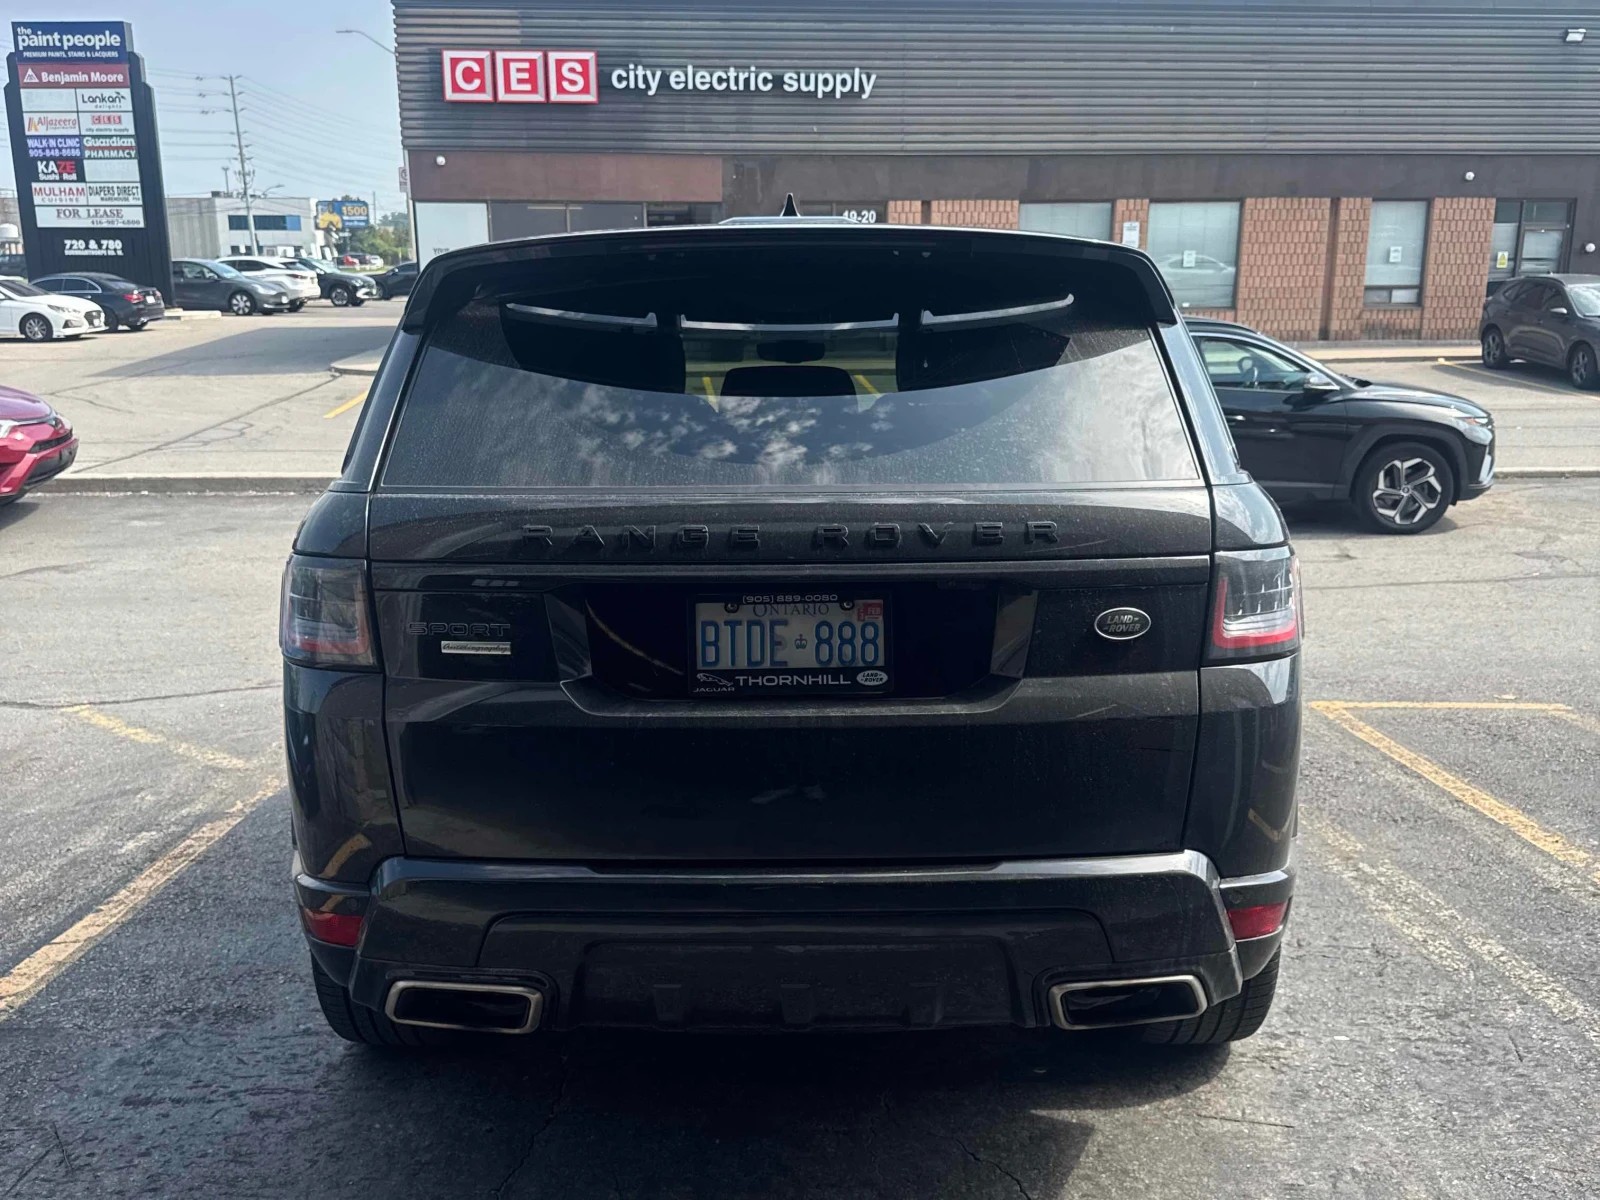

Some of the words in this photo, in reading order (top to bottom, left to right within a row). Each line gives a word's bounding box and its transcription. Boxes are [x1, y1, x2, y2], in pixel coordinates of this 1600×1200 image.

[17, 26, 32, 34] the
[18, 30, 61, 50] paint
[62, 30, 121, 50] people
[41, 71, 88, 85] Benjamin
[91, 72, 124, 82] Moore
[454, 59, 587, 94] CES
[610, 63, 662, 97] city
[668, 64, 773, 93] electric
[782, 67, 877, 100] supply
[82, 92, 121, 103] Lankan
[37, 116, 77, 131] Aljazeera
[27, 138, 56, 148] WALK-IN
[57, 138, 80, 148] CLINIC
[83, 136, 136, 146] Guardian
[84, 149, 136, 158] PHARMACY
[37, 160, 76, 173] KAZE
[34, 187, 86, 196] MULHAM
[88, 186, 115, 196] DIAPERS
[117, 186, 139, 196] DIRECT
[56, 208, 81, 218] FOR
[86, 208, 124, 218] LEASE
[342, 206, 367, 216] 1500
[842, 210, 876, 223] 19-20
[64, 239, 86, 250] 720
[88, 239, 98, 250] &
[101, 239, 122, 250] 780
[522, 523, 761, 550] RANGE
[817, 521, 1059, 548] ROVER
[752, 602, 830, 617] ONTARIO
[408, 622, 511, 637] SPORT
[701, 619, 788, 668] BTDE
[814, 620, 880, 667] 888
[735, 674, 852, 687] THORNHILL
